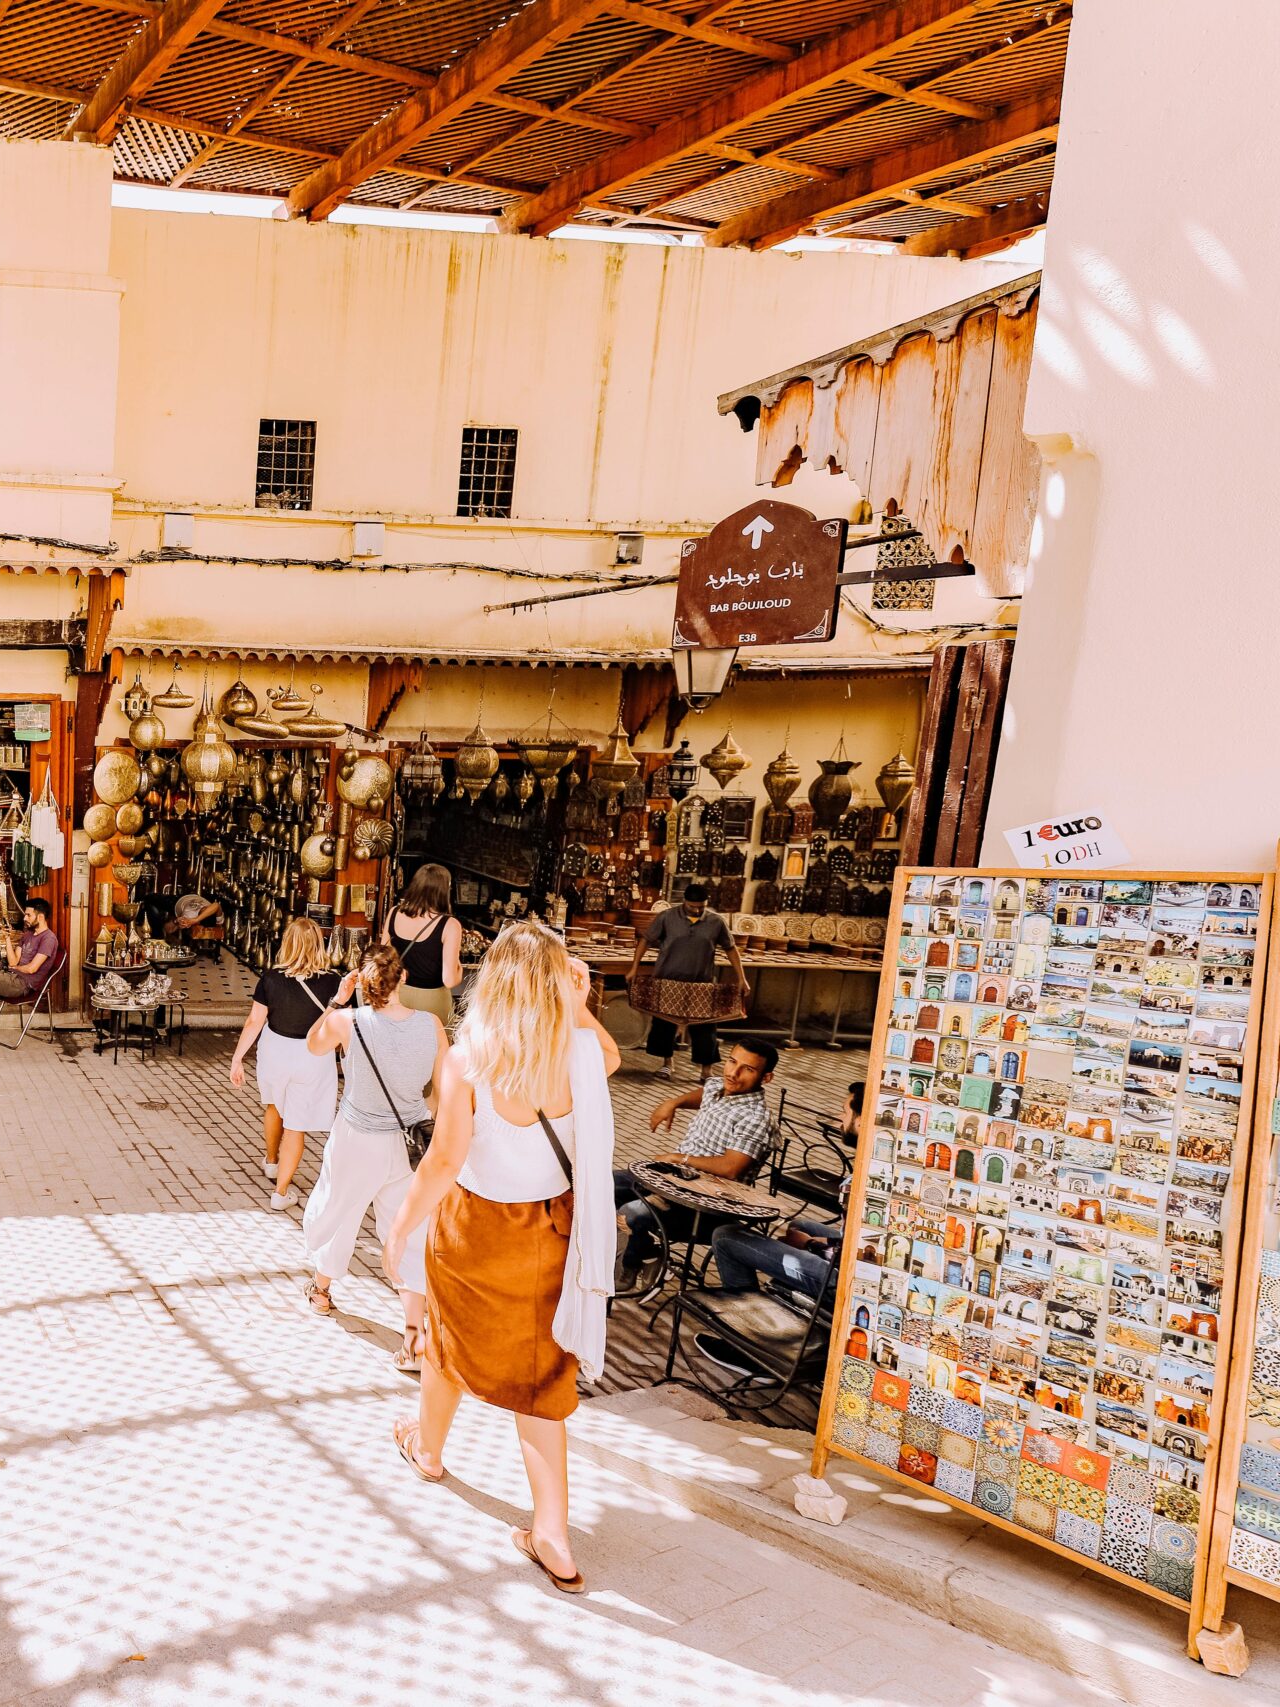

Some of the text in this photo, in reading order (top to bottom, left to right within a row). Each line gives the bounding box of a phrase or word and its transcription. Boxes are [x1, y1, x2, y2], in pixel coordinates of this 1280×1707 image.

[705, 561, 804, 590] باب بوجلود
[710, 598, 792, 613] BAB BOUJLOUD
[738, 633, 757, 643] E38
[1021, 830, 1037, 848] 1
